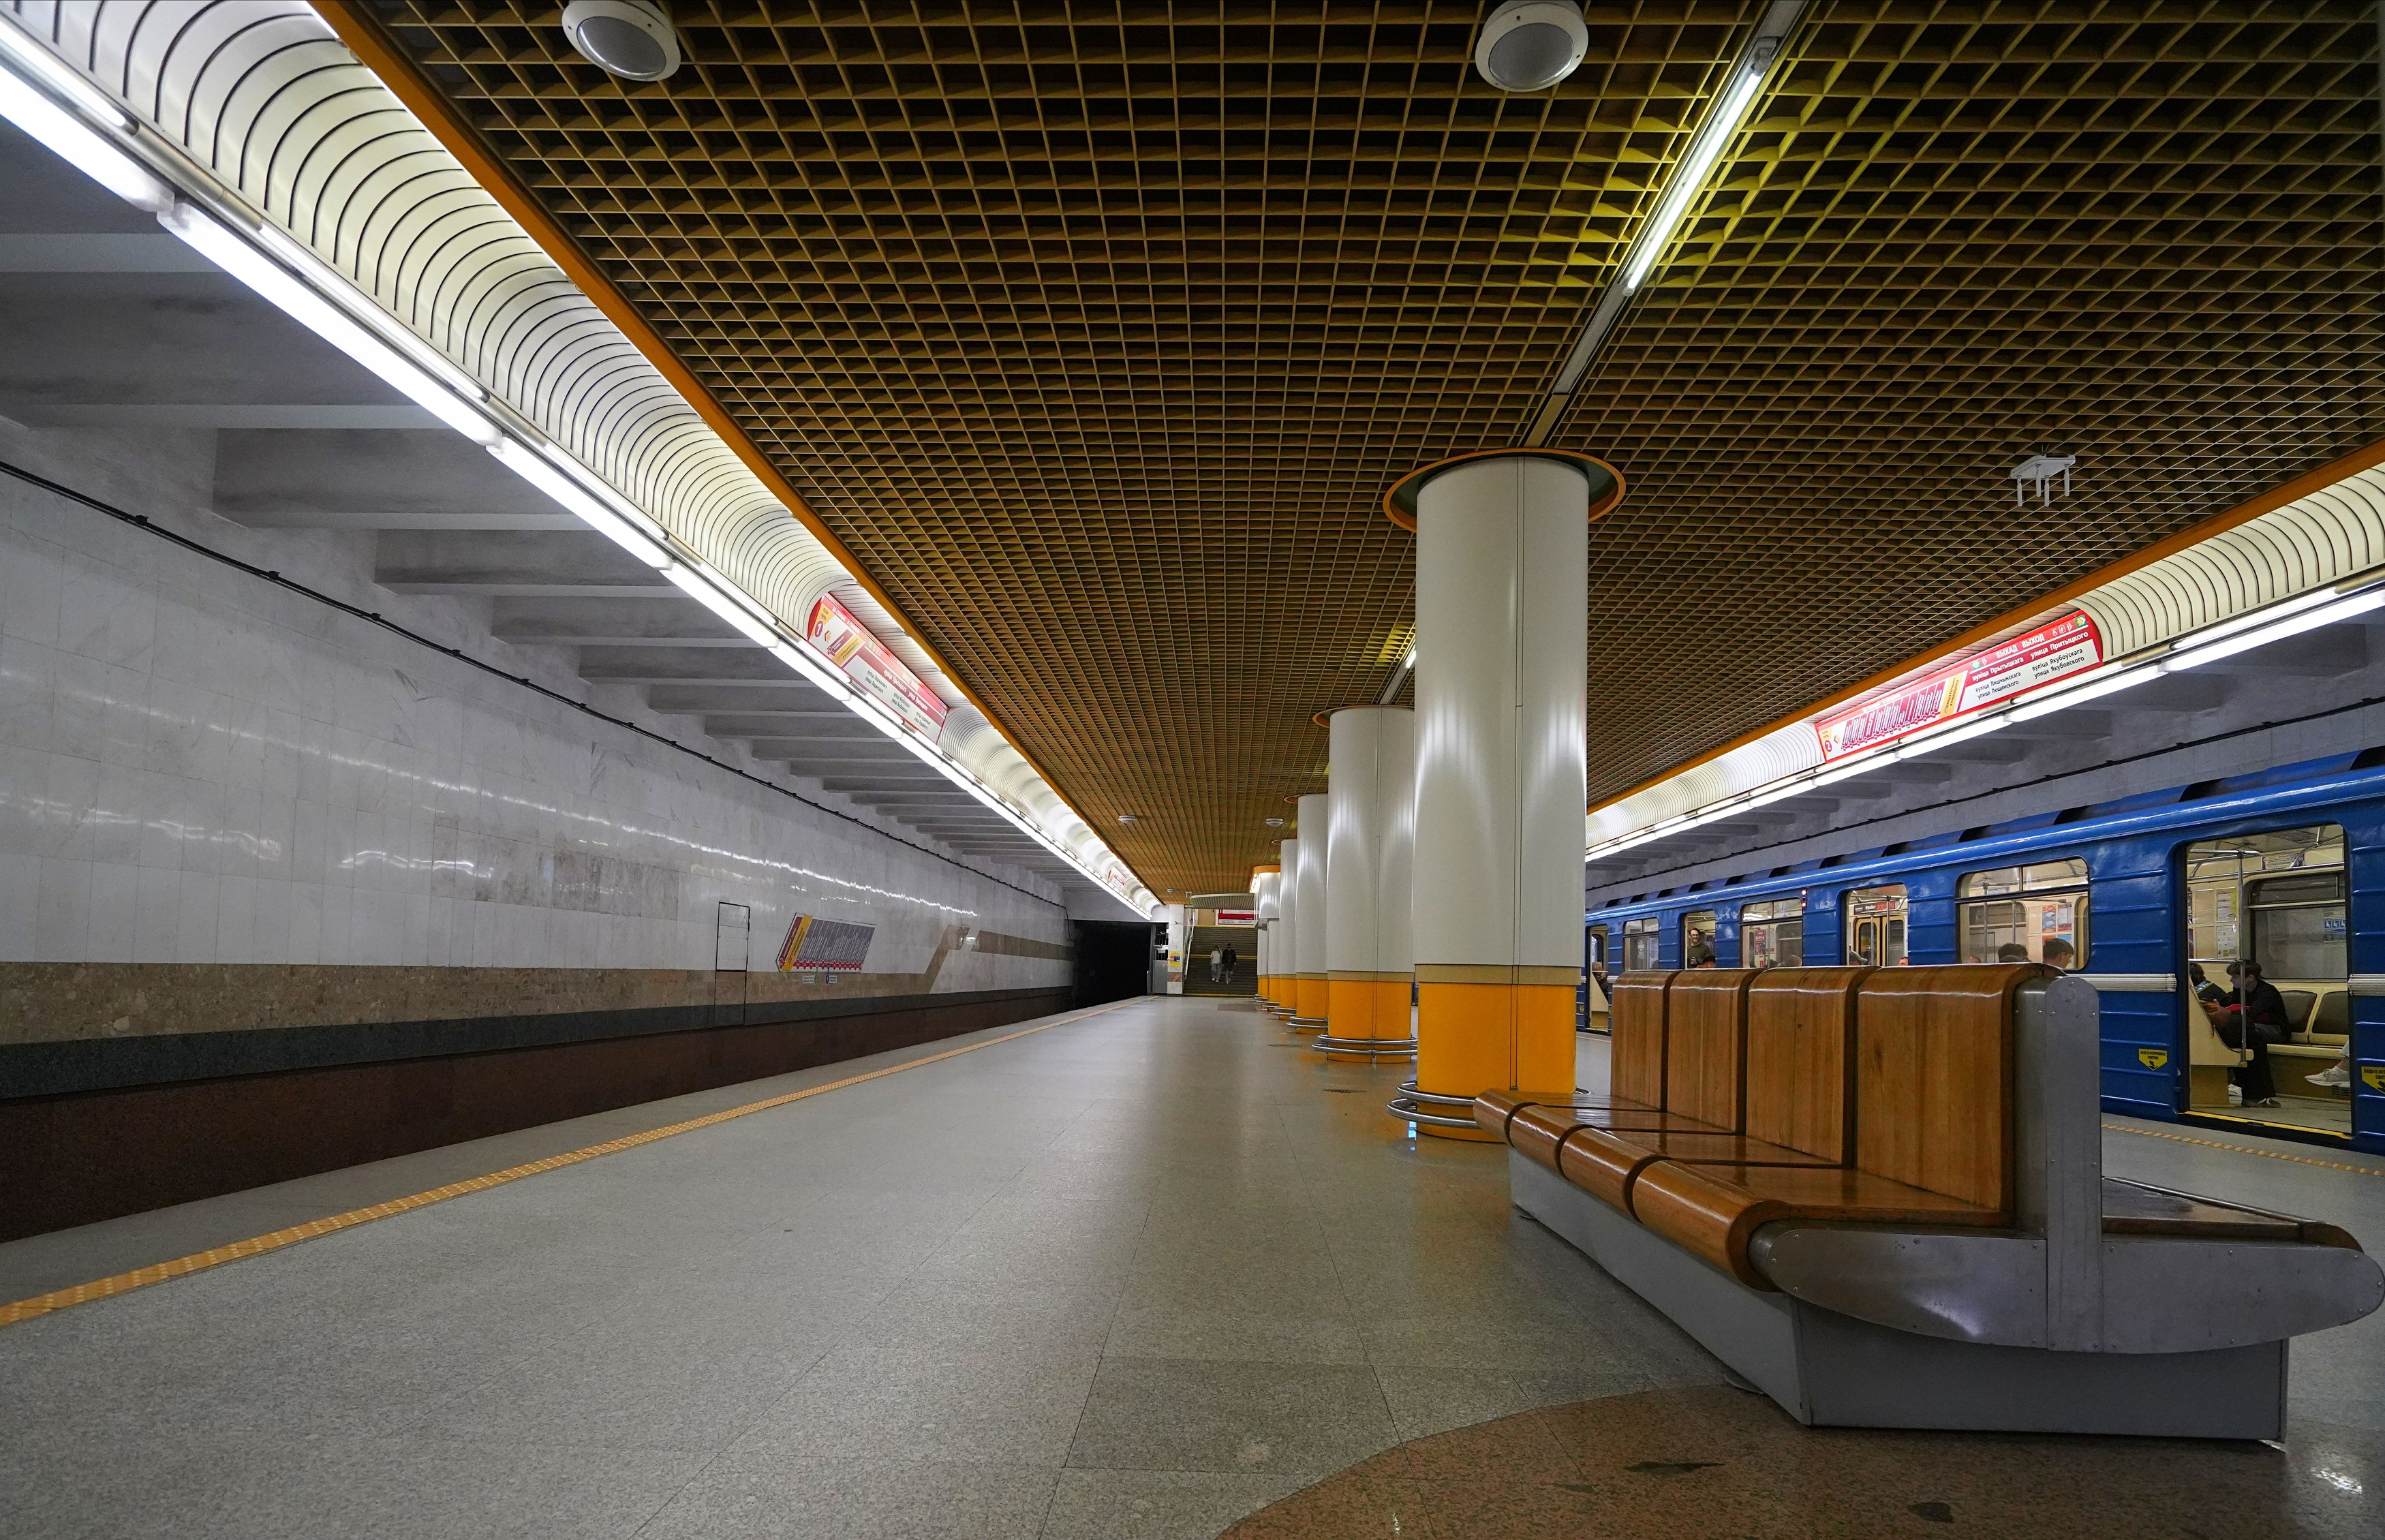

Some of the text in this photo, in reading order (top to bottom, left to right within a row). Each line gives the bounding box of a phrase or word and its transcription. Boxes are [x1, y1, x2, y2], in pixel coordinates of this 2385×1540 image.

[816, 623, 822, 636] 1
[1972, 632, 2089, 681] вуліца Прытыцкага улица Притыцкого
[1996, 634, 2045, 659] ВЫХАД ВЫХОД
[2032, 648, 2083, 671] вуліца Якубоўскага
[2033, 656, 2084, 679] улица Якубовского
[1975, 671, 2021, 692] вуліца Ляшчынскага
[1978, 680, 2019, 700] улица Лещинского
[1826, 741, 1832, 750] 2
